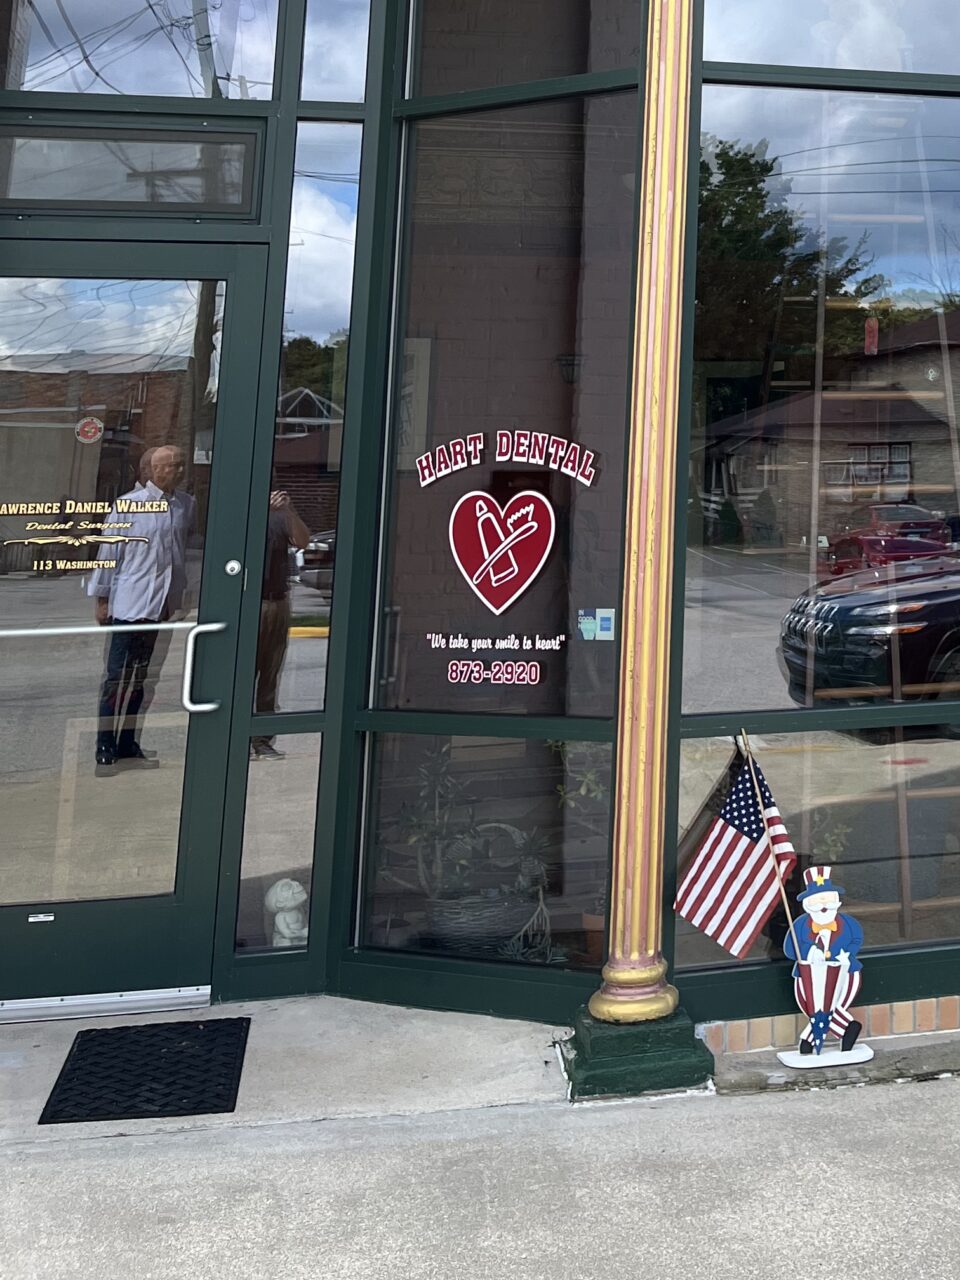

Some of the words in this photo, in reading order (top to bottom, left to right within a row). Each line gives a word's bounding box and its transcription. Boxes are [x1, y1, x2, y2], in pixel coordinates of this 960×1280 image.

[416, 432, 484, 488] HART
[495, 430, 596, 487] DENTAL
[25, 521, 74, 531] Dental
[77, 521, 132, 531] Surgeon
[33, 560, 53, 570] 113
[449, 633, 469, 649] take
[471, 637, 492, 653] your
[495, 634, 520, 650] smile
[523, 635, 533, 650] to
[448, 660, 540, 685] 873-2920
